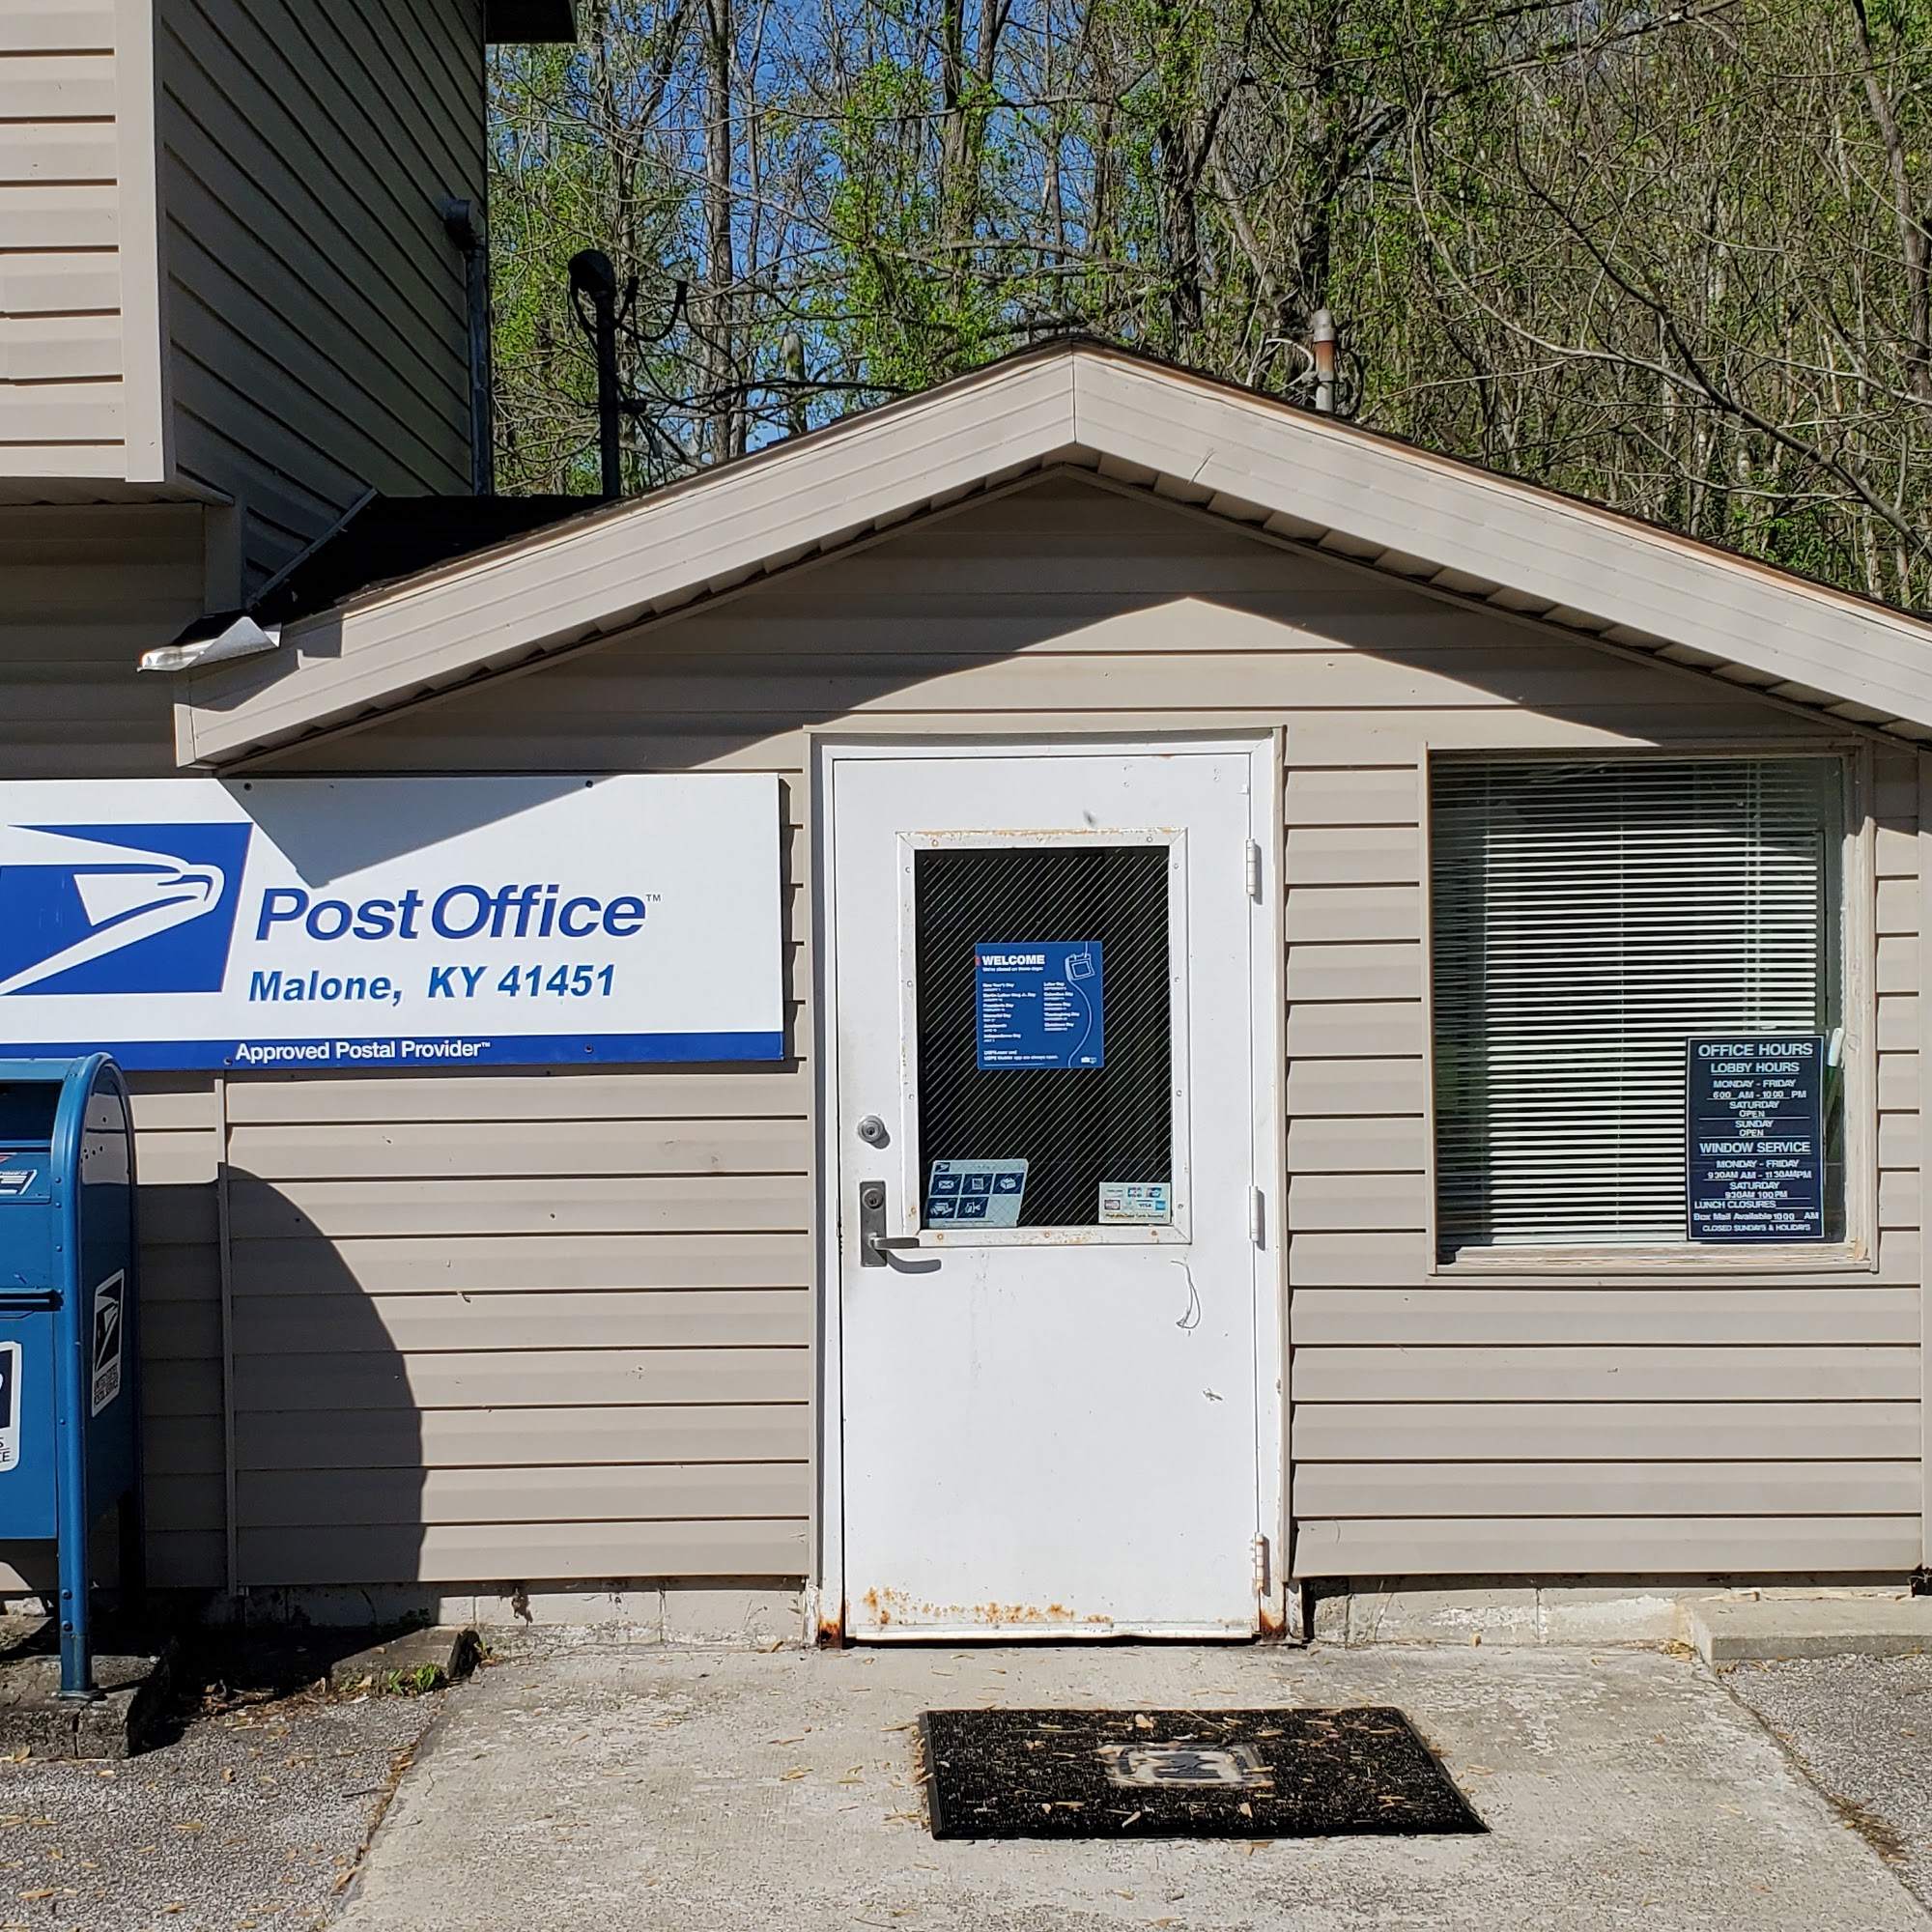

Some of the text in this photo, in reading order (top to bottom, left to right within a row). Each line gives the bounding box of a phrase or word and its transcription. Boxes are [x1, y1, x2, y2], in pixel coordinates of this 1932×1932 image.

[255, 887, 423, 941] Post
[981, 954, 1045, 966] WELCOME
[248, 964, 615, 1008] Malone, KY 41451
[236, 1042, 330, 1065] Approved
[335, 1040, 396, 1059] Postal
[1698, 1043, 1813, 1057] OFFICE HOURS
[1710, 1062, 1800, 1073] LOBBY HOURS
[1763, 1079, 1796, 1088] FRIDAY
[1791, 1090, 1806, 1098] PM
[1735, 1120, 1774, 1128] SUNDAY
[1699, 1141, 1811, 1153] WINDOW SERVICE
[1766, 1159, 1800, 1168] FRIDAY
[1729, 1181, 1780, 1190] SATURDAY
[1694, 1200, 1776, 1209] LUNCH CLOSURES
